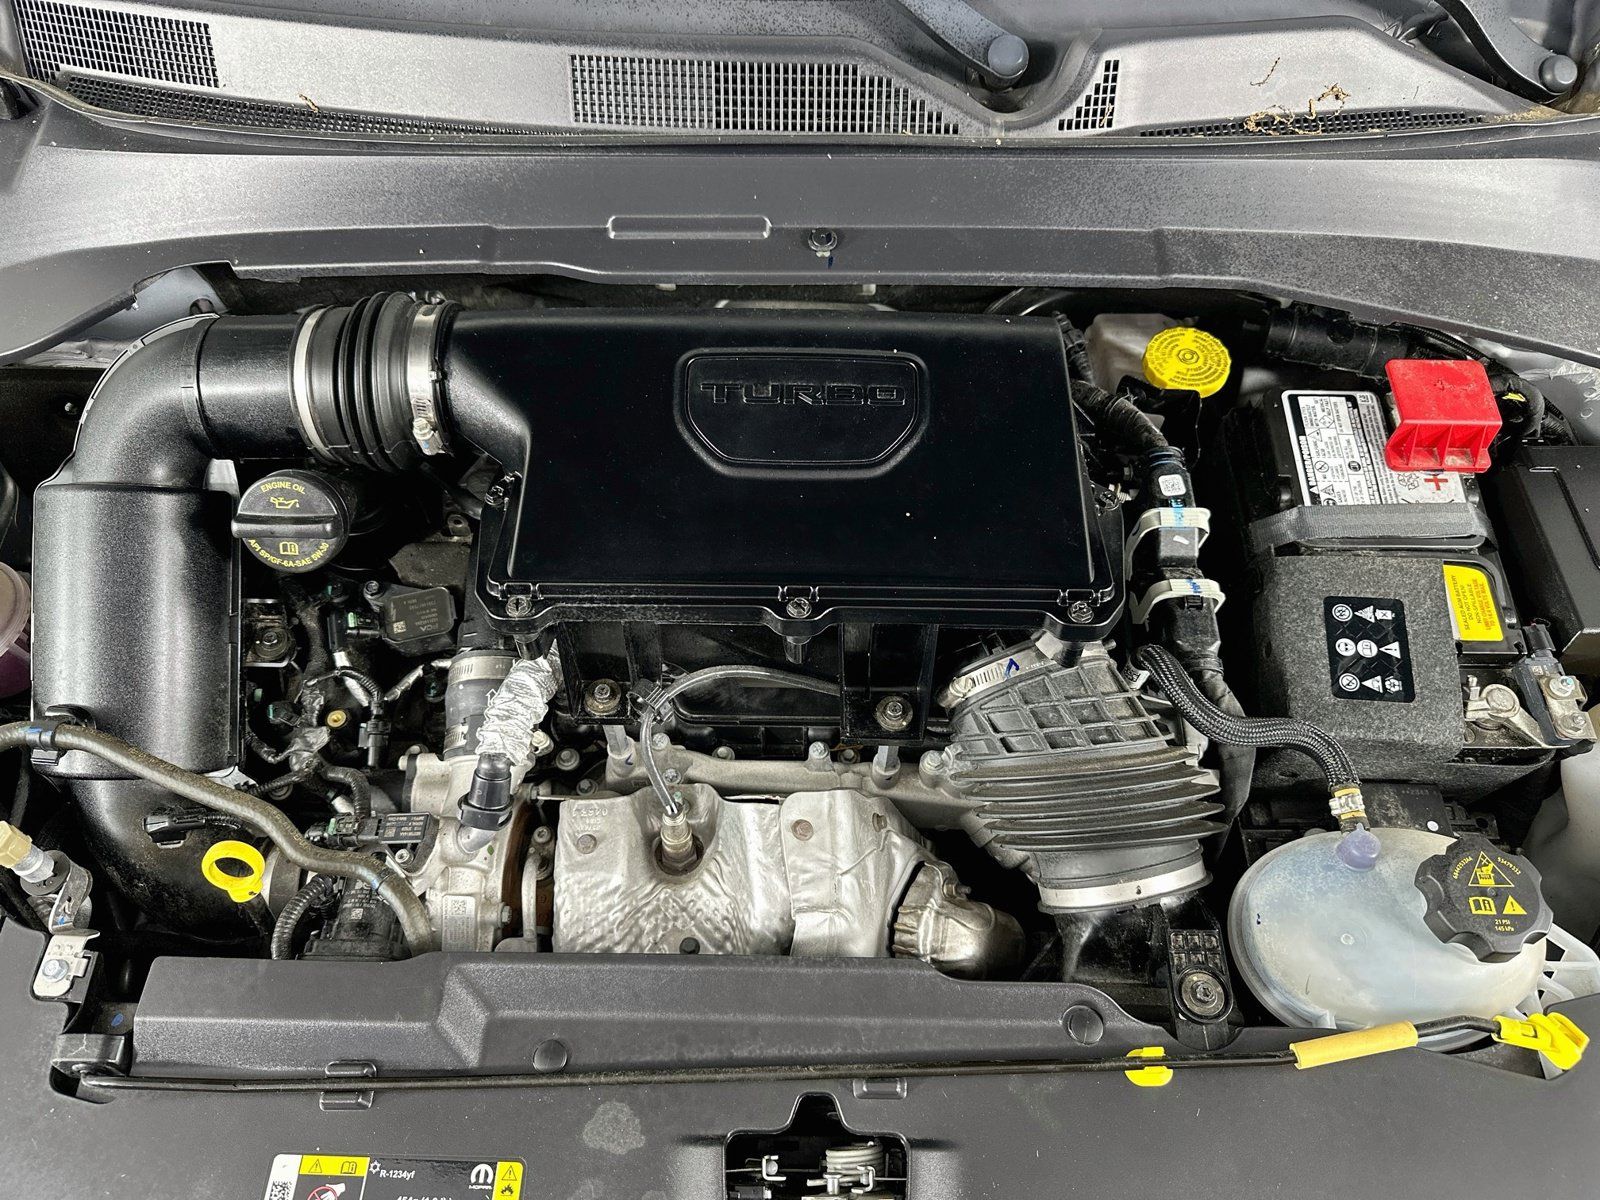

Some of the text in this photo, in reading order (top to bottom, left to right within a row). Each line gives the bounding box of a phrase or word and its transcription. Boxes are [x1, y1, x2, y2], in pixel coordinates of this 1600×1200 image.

[700, 383, 905, 405] TURBO
[260, 482, 305, 494] ENGINE OIL
[248, 539, 261, 552] API
[311, 542, 329, 560] 5W-30
[1451, 575, 1461, 597] BATTERY
[380, 1170, 415, 1180] R-1234yf
